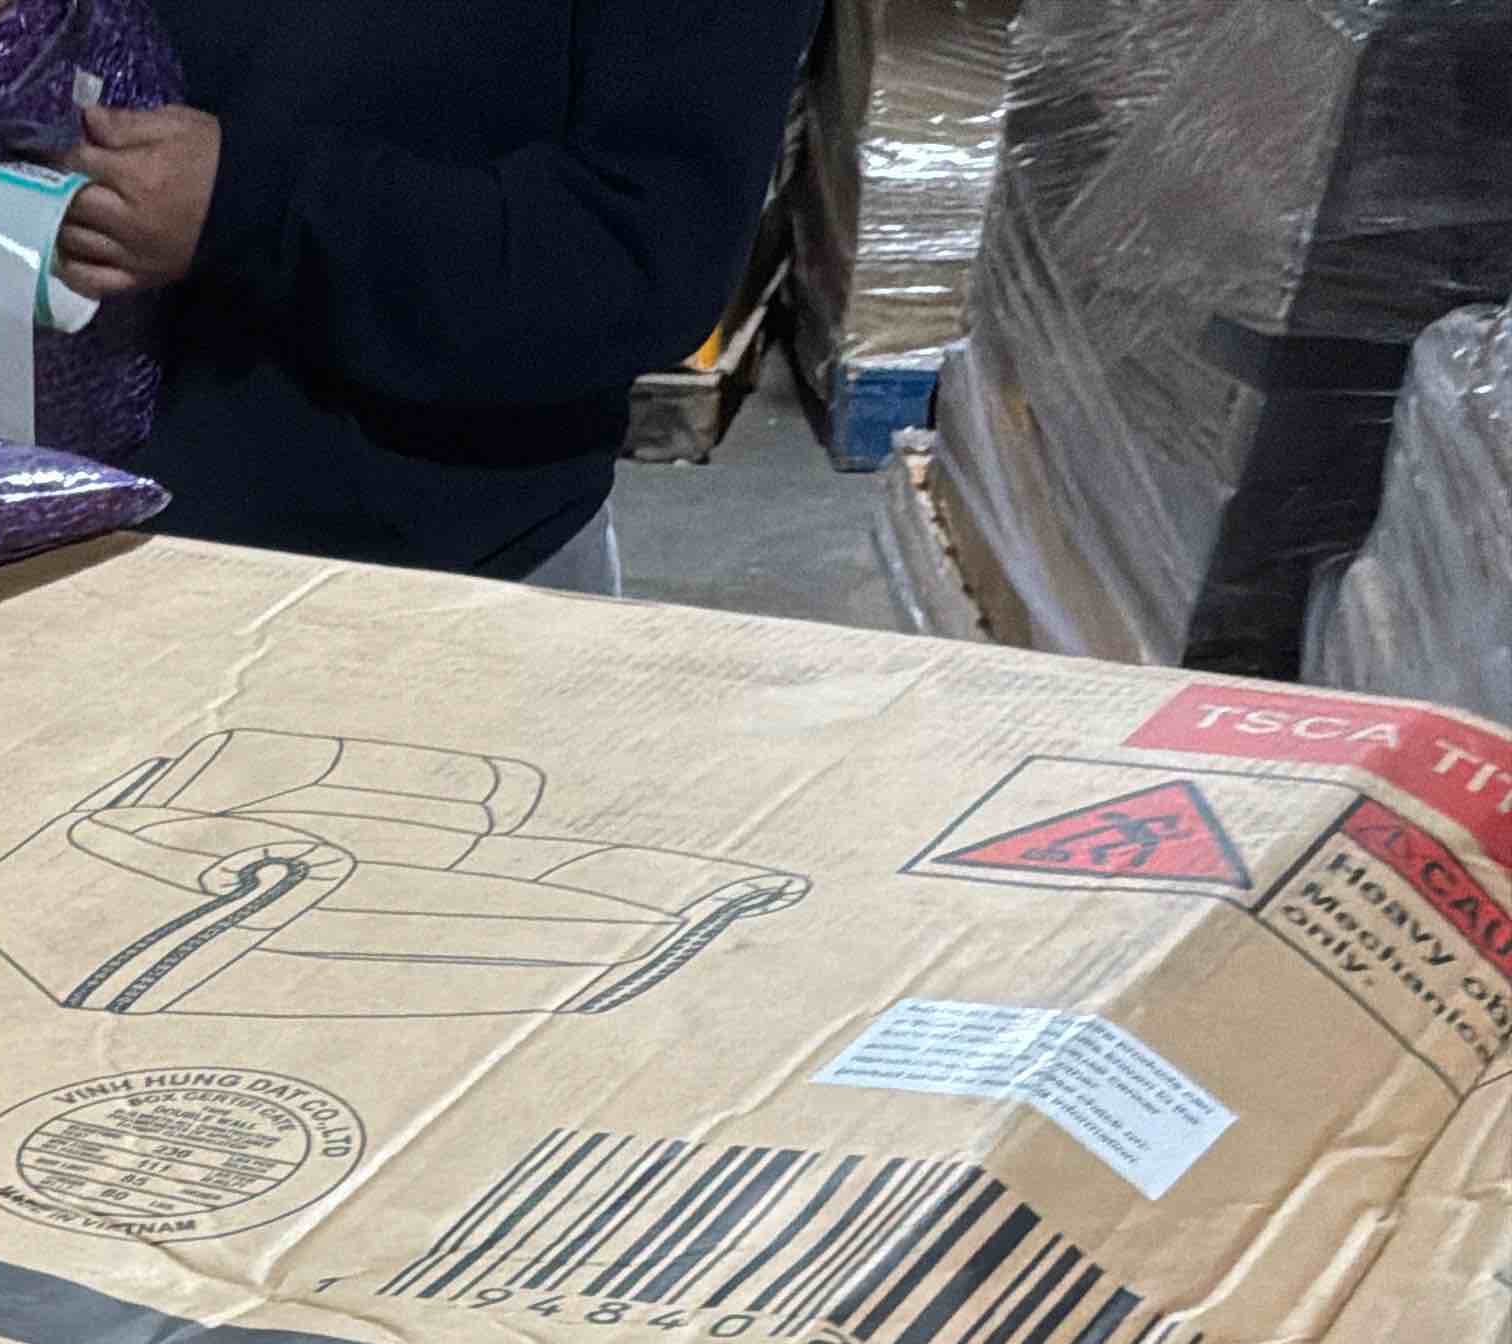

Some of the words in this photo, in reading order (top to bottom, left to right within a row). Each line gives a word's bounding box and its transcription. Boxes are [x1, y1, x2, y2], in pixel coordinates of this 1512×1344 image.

[1193, 703, 1399, 748] TSCA
[1327, 852, 1455, 966] Heavy
[53, 1079, 134, 1104] VINH
[144, 1073, 242, 1088] HUNG
[245, 1078, 310, 1101] DAT
